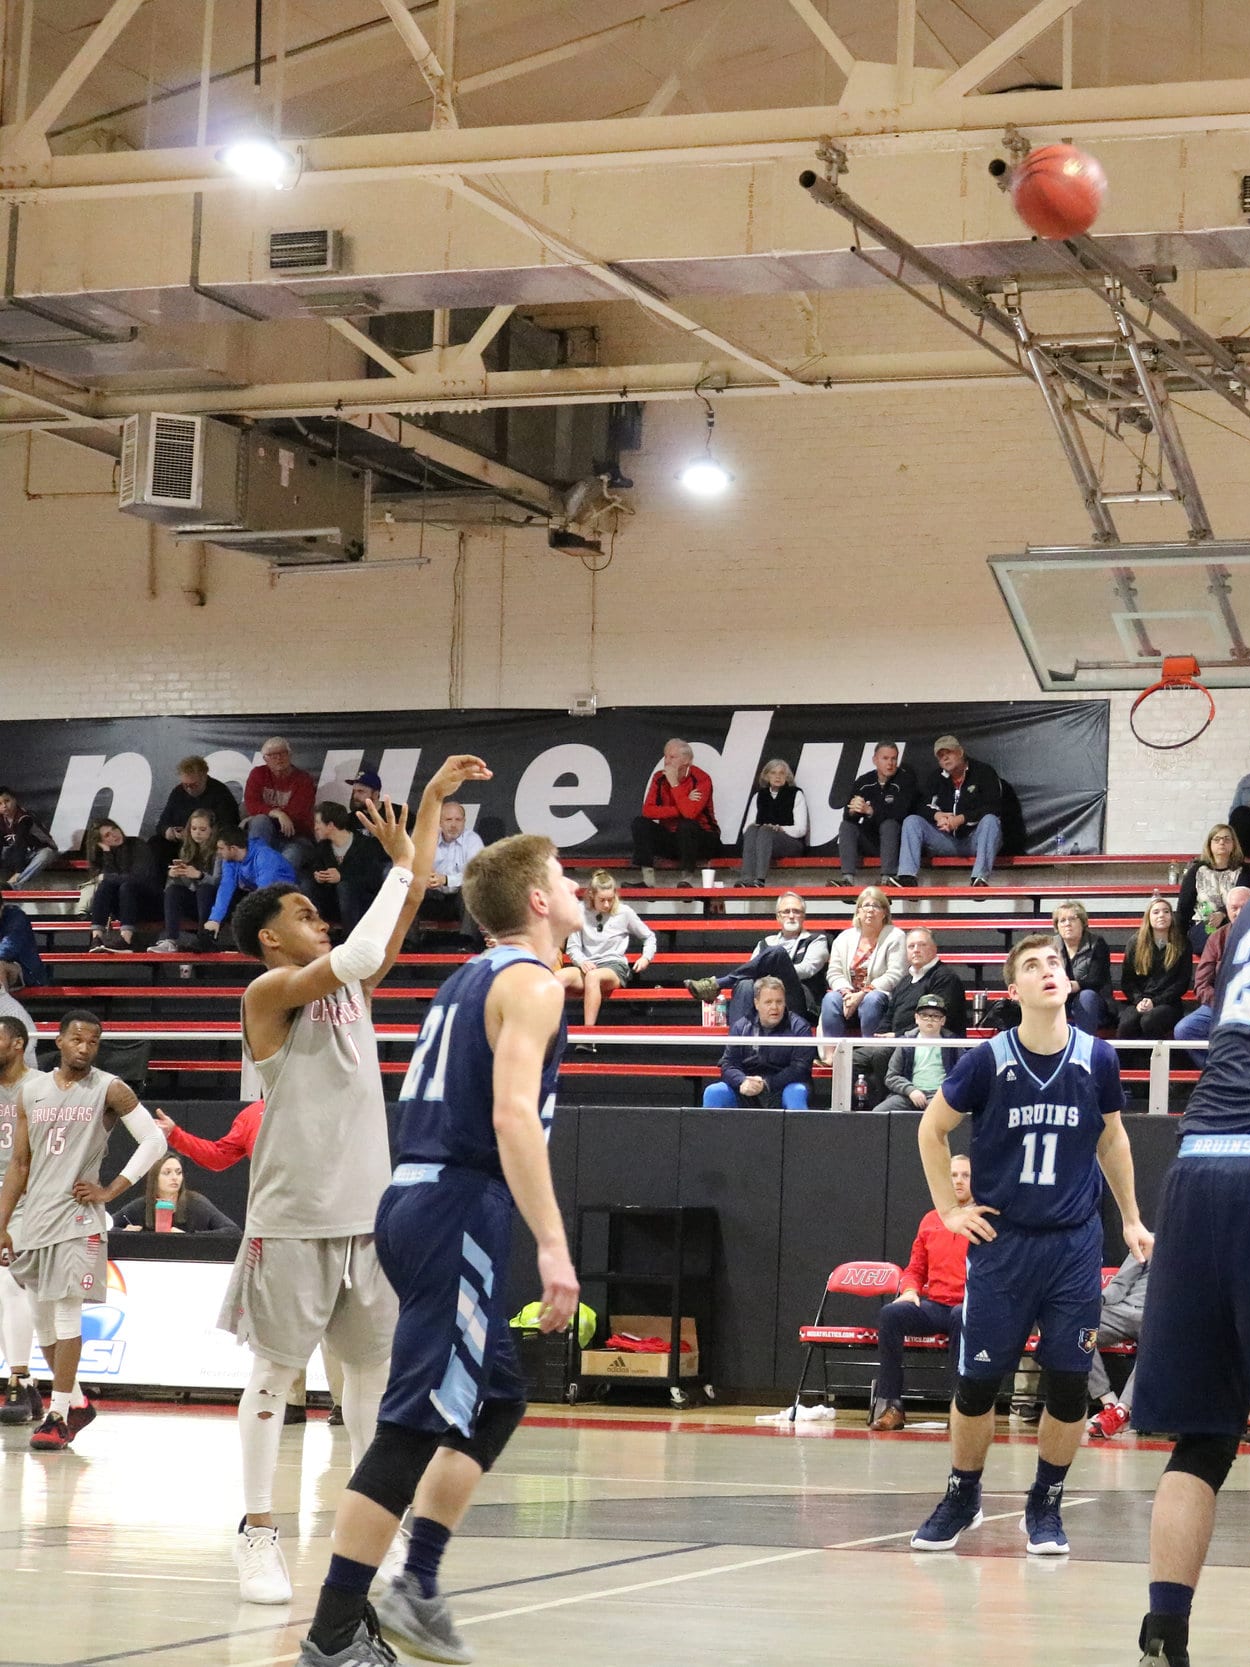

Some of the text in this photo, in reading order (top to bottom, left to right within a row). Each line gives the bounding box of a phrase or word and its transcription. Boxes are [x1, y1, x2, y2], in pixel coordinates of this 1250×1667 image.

[399, 1003, 459, 1101] 21
[1008, 1104, 1079, 1128] BRUINS
[46, 1126, 67, 1156] 15
[1019, 1132, 1058, 1185] 11
[841, 1268, 893, 1286] NGU
